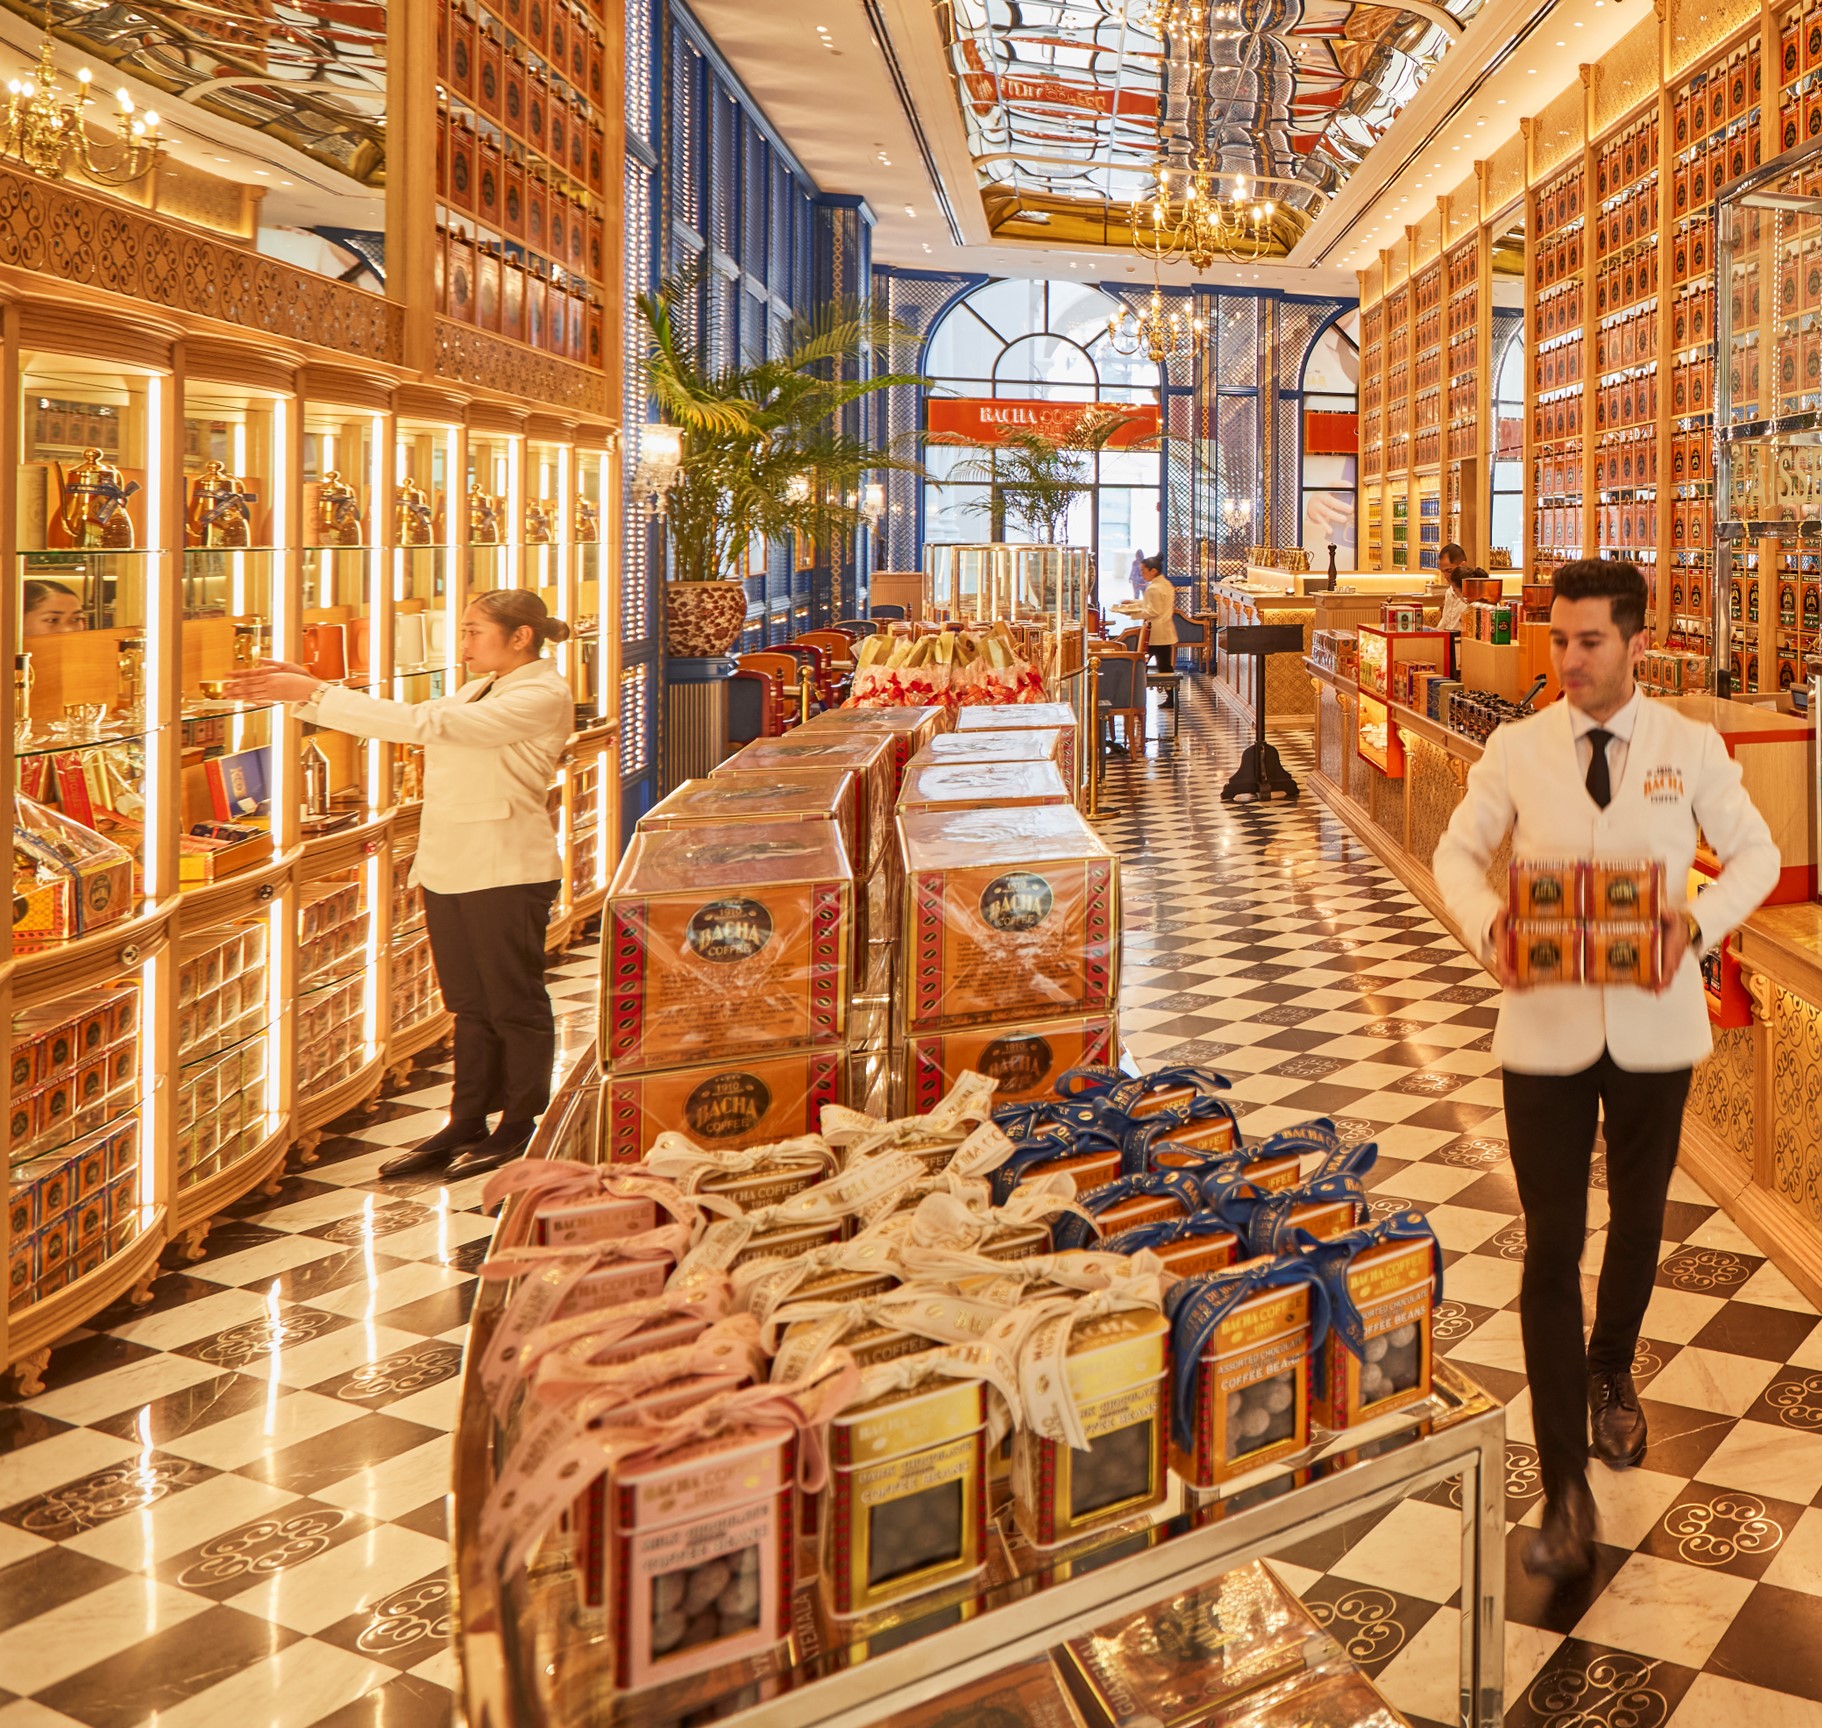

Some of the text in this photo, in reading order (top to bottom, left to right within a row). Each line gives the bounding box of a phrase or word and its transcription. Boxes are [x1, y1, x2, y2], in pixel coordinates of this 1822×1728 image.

[980, 407, 1038, 424] BACHA
[1643, 775, 1684, 798] BACHA
[1007, 880, 1026, 889] 1910
[719, 907, 741, 918] 1910
[990, 895, 1042, 920] BACHA
[998, 915, 1035, 927] COFFEE
[701, 921, 759, 949] BACHA
[708, 944, 751, 957] COFFEE
[1005, 1043, 1025, 1051] 1910
[989, 1056, 1040, 1078] BACHA
[715, 1082, 739, 1093] 1910
[697, 1097, 758, 1128] BACHA
[706, 1119, 748, 1133] COFFEE
[757, 1181, 807, 1198] COFFEE
[1350, 1253, 1425, 1290] BACHA COFFEE
[1381, 1277, 1400, 1289] 1910
[1221, 1313, 1259, 1336] BACHA
[1259, 1296, 1303, 1320] COFFEE
[1362, 1304, 1426, 1337] OFFEE BEANS
[1254, 1320, 1274, 1334] 1910
[1218, 1336, 1305, 1375] ASSORTED CHOCOLATE
[1221, 1354, 1302, 1392] COFFEE BEANS
[861, 1480, 920, 1504] COFFEE
